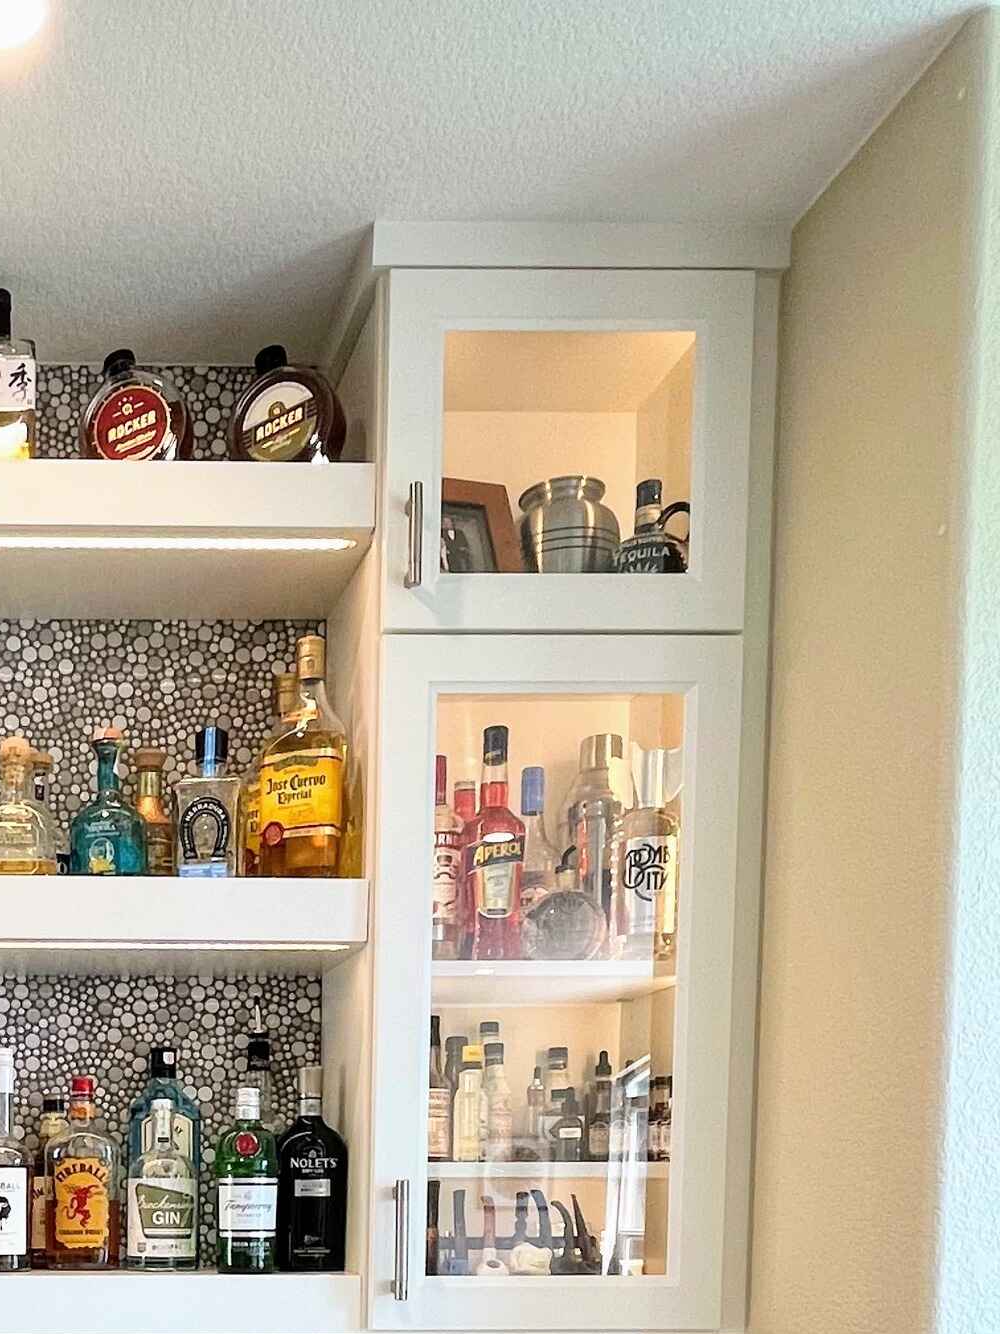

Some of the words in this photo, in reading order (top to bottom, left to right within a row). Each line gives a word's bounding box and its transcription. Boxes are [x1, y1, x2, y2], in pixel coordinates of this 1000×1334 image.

[107, 409, 157, 443] ROCKER
[255, 406, 304, 443] ROCKER
[56, 1162, 107, 1183] FIREBALL
[152, 1210, 181, 1225] GIN
